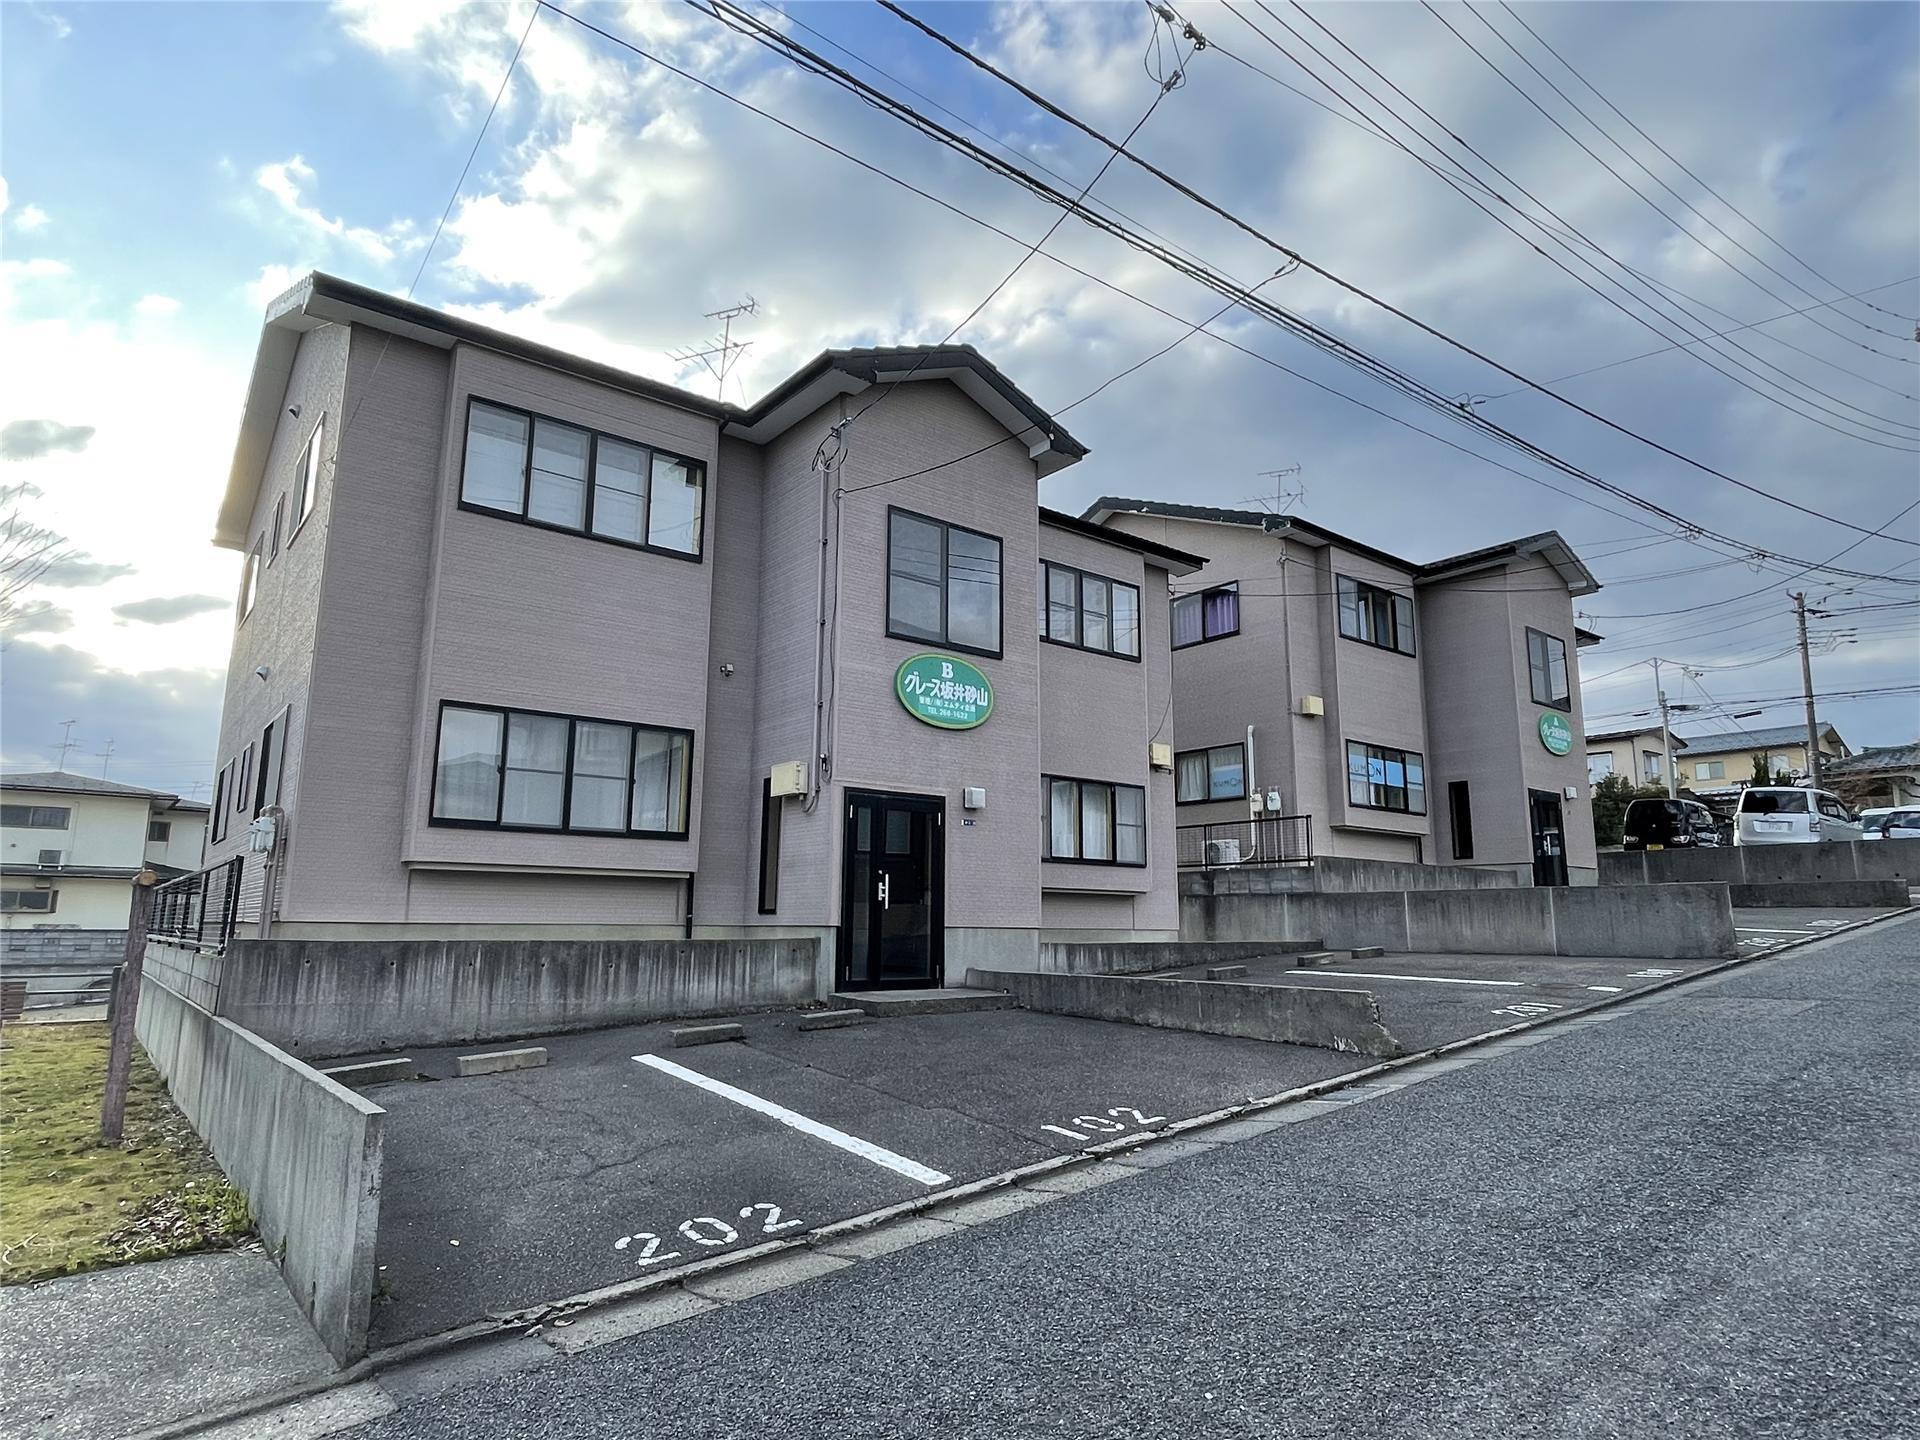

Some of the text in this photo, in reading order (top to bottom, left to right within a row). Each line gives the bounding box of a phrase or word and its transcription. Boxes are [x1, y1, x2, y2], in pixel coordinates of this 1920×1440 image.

[941, 662, 954, 679] B
[904, 671, 988, 707] グレース坂井砂山
[1041, 1107, 1167, 1141] 102
[614, 1203, 803, 1266] 202
